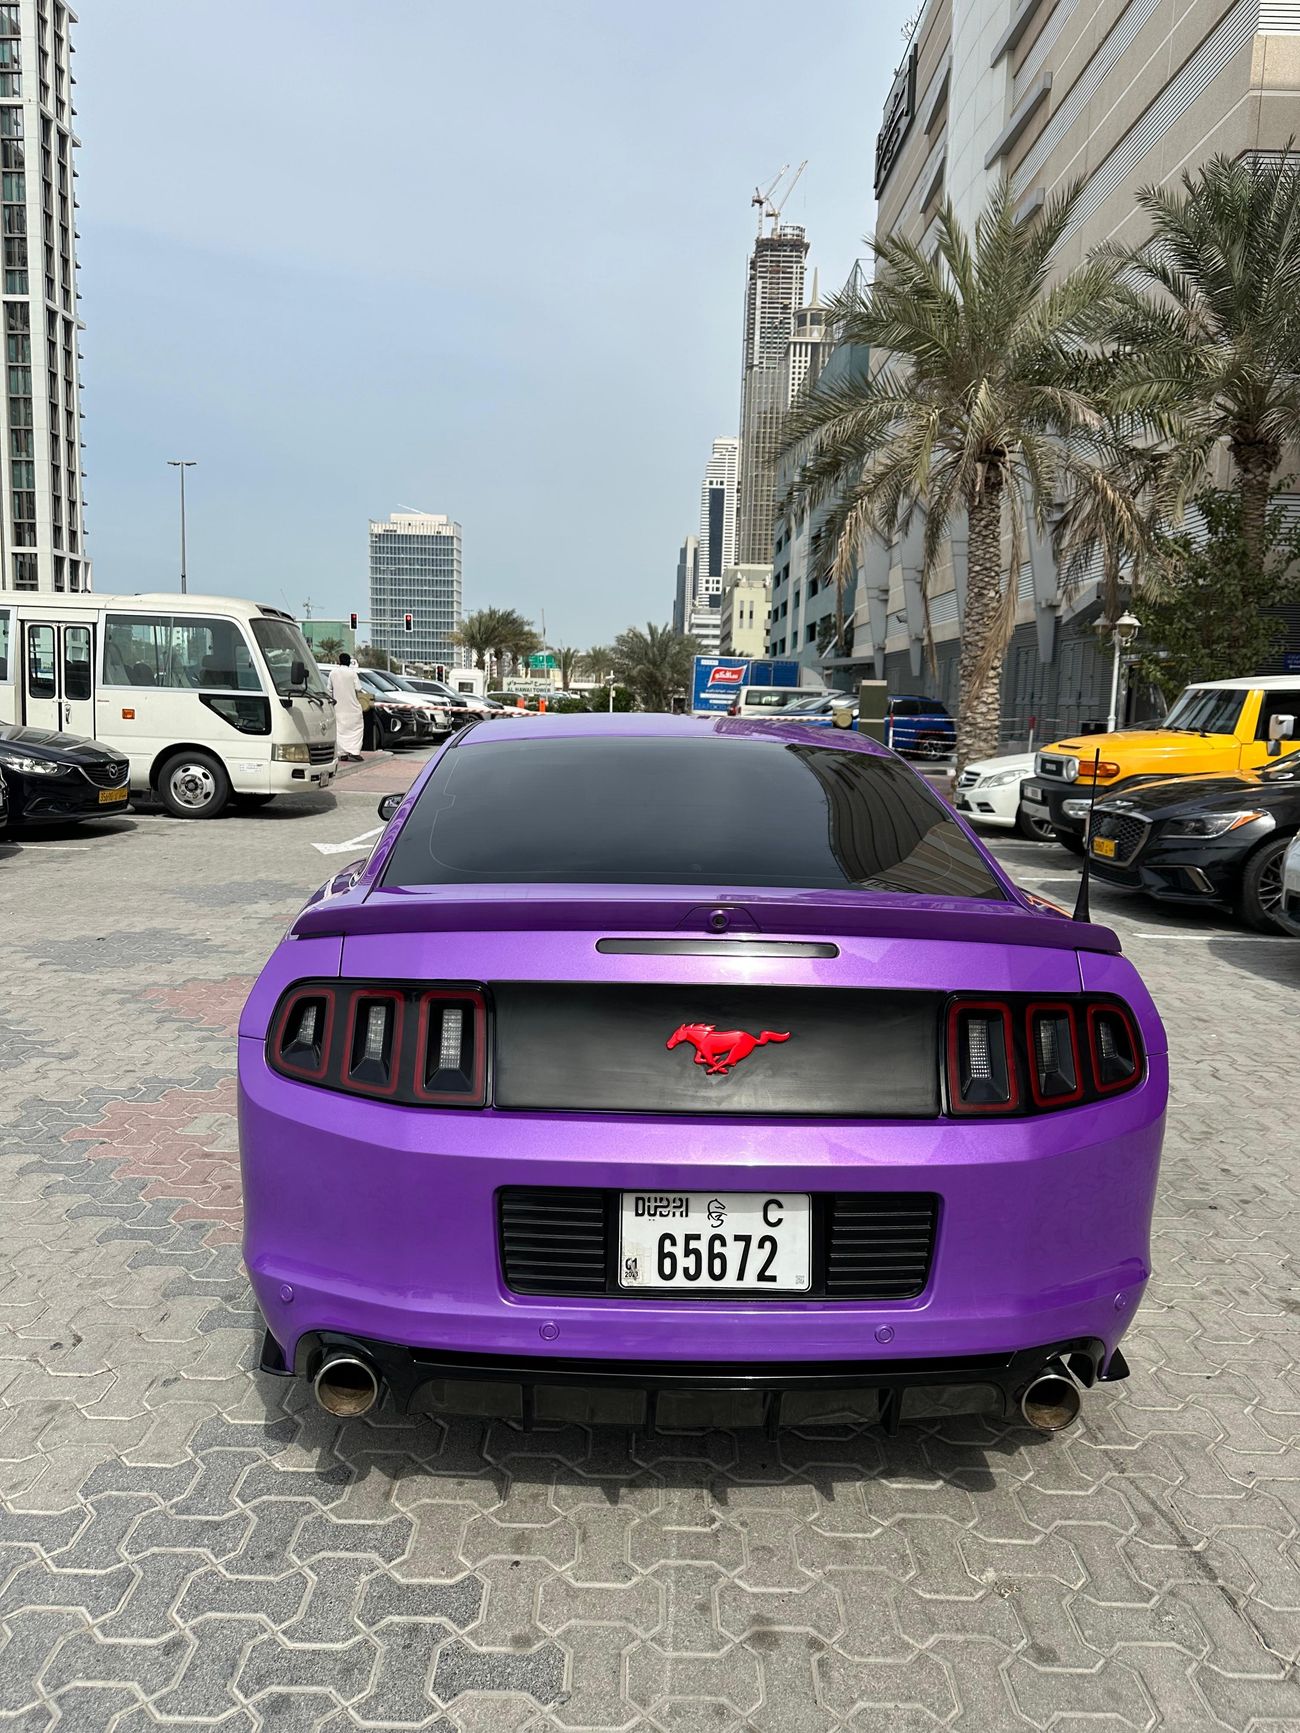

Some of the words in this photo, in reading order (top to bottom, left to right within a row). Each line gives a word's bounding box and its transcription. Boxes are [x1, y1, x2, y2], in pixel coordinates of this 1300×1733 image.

[635, 1196, 689, 1218] DUBAI
[763, 1199, 784, 1228] C
[657, 1232, 778, 1283] 65672
